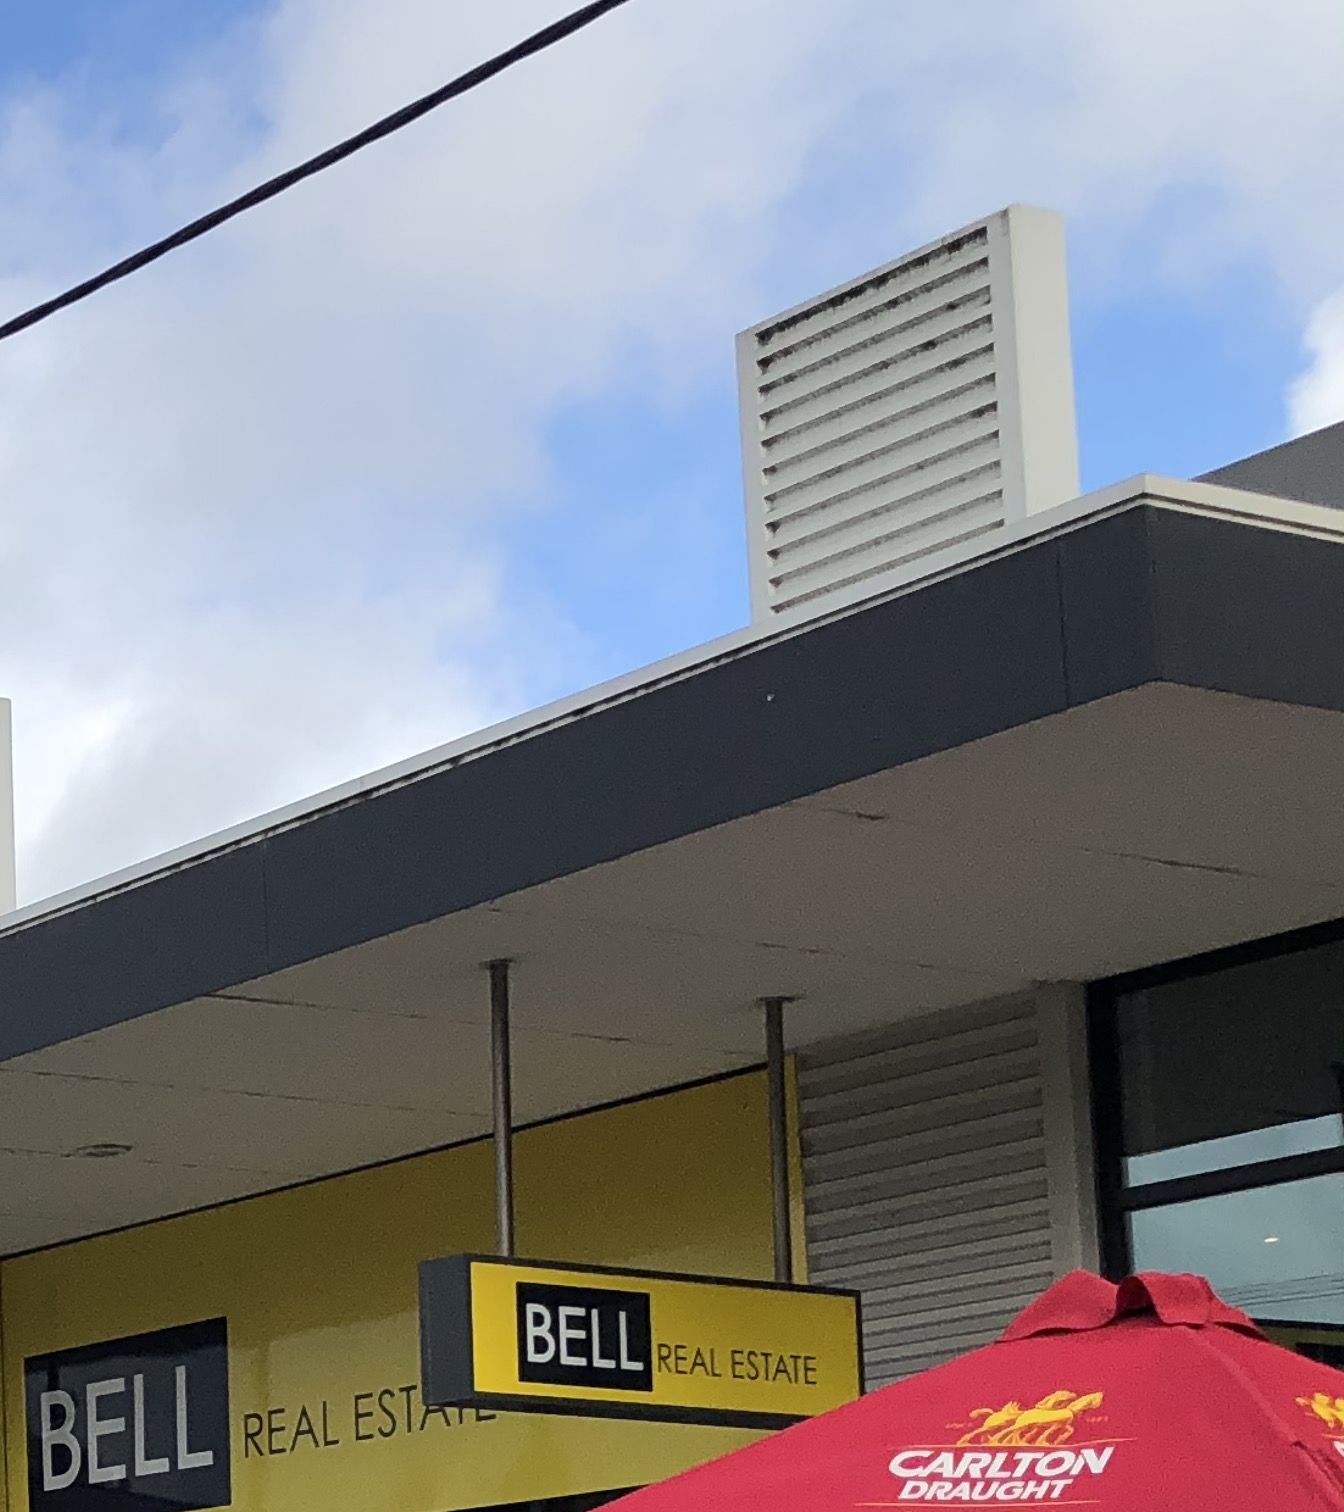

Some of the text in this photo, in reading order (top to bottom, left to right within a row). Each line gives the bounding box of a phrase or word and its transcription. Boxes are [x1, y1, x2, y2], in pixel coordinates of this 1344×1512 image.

[525, 1302, 644, 1371] BELL
[657, 1343, 818, 1385] REAL ESTATE
[40, 1364, 214, 1492] BELL
[243, 1400, 340, 1458] REAL
[888, 1446, 1115, 1479] CARLTON
[898, 1478, 1073, 1500] DRAUGHT
